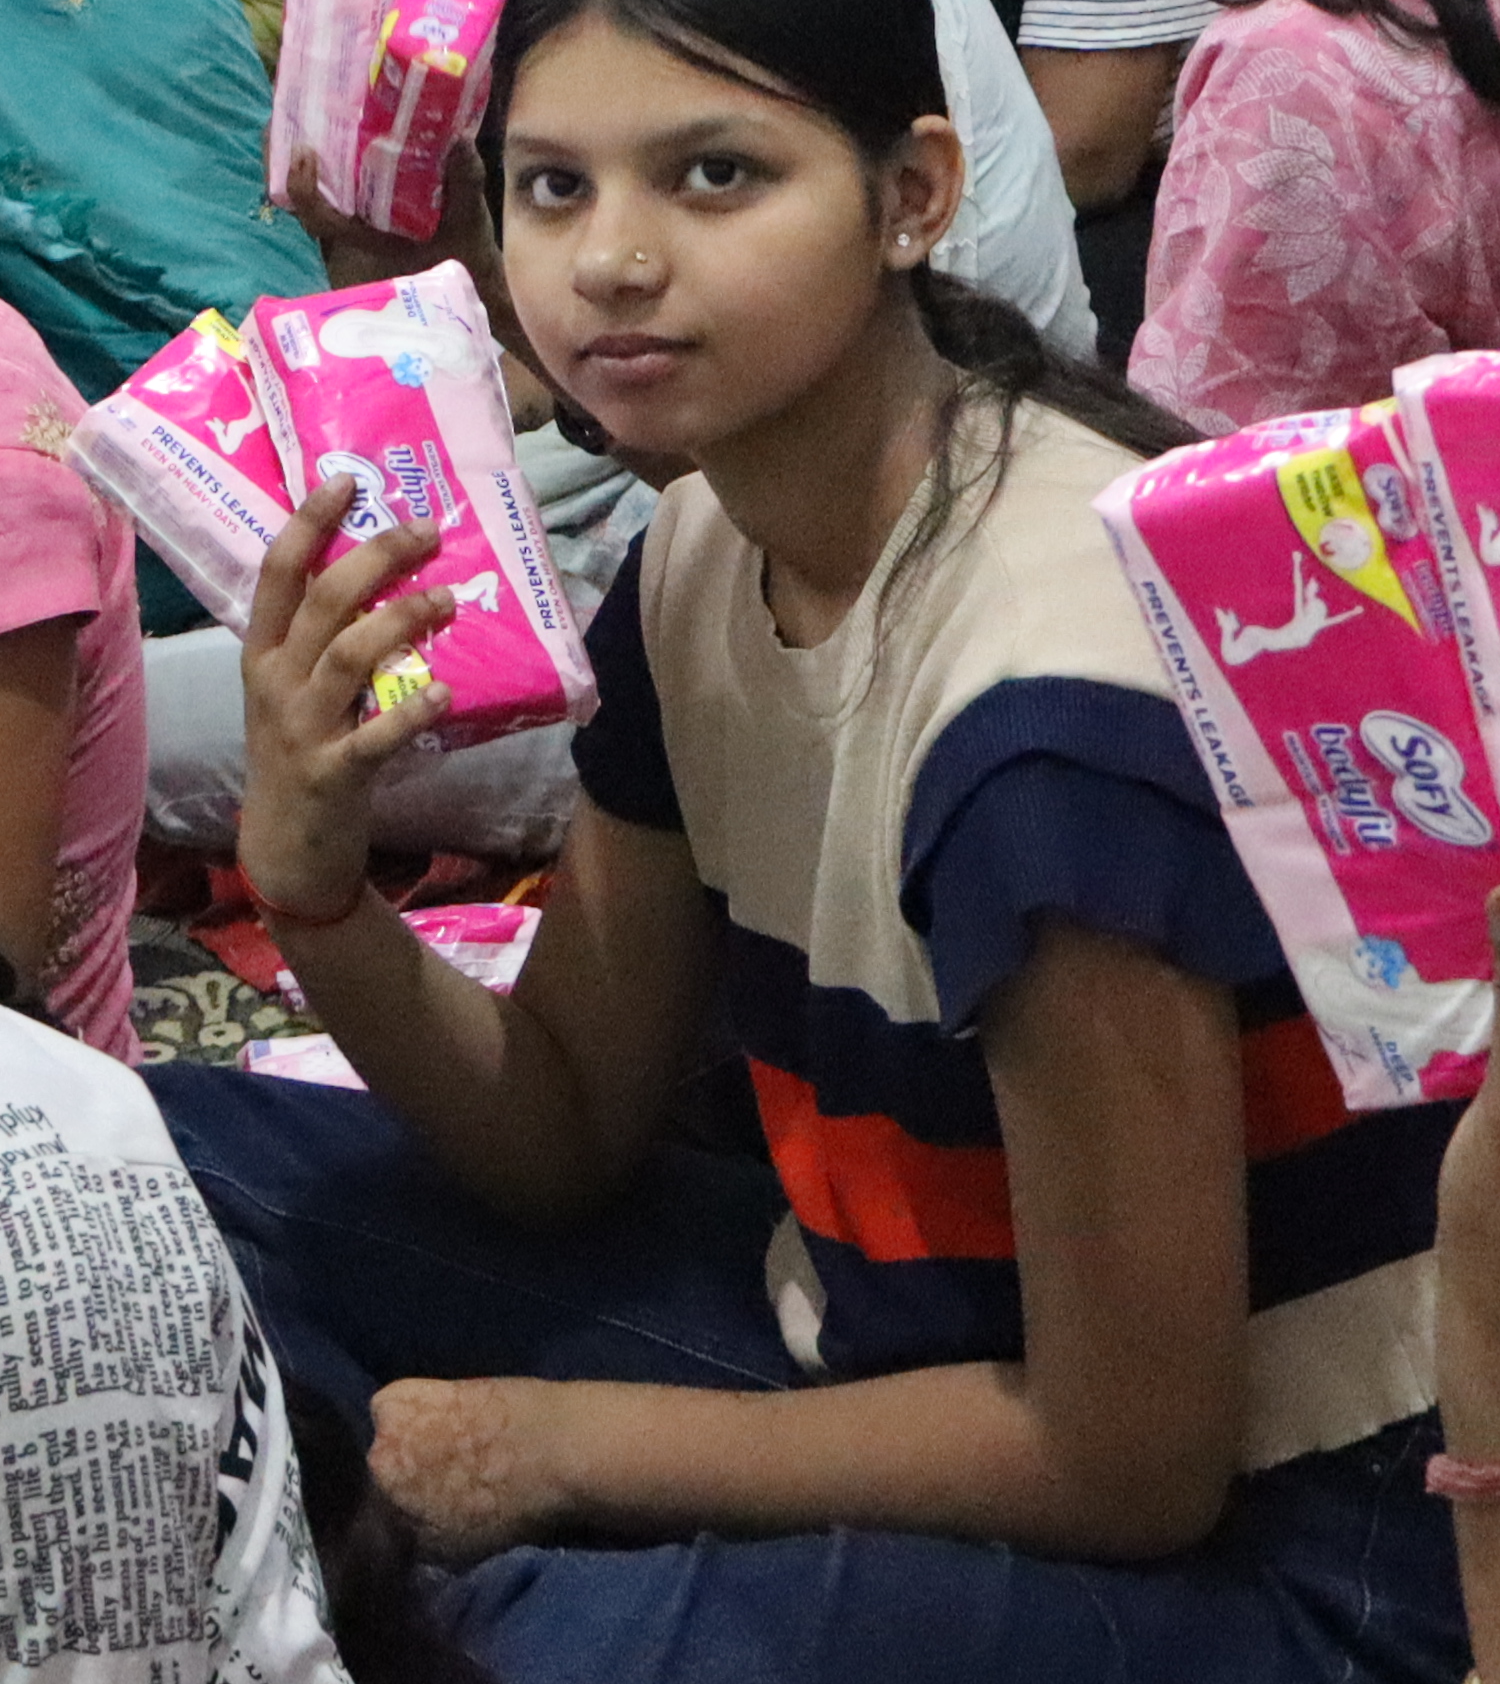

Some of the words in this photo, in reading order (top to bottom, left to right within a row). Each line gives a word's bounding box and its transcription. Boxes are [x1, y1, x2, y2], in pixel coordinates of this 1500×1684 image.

[401, 288, 417, 318] DEEP
[141, 438, 169, 465] EVEN
[167, 462, 184, 480] ON
[183, 477, 216, 508] HEAVY
[213, 506, 241, 535] DAYS
[152, 425, 223, 494] PREVENTS
[220, 491, 277, 547] LEAKAG
[387, 446, 433, 520] odyfit
[491, 469, 528, 542] LEAKAGE
[518, 546, 558, 631] PREVENTS
[553, 599, 569, 631] EVEN
[1421, 460, 1464, 592] PREVENTS
[1451, 601, 1497, 717] LEAKAGE
[1141, 579, 1204, 703] PREVENTS
[1194, 706, 1256, 810] LEAKAGE
[1311, 723, 1400, 850] bodyfit
[1390, 733, 1457, 820] SOFY
[1386, 1040, 1415, 1084] DEEP
[21, 1171, 36, 1189] to
[33, 1196, 59, 1251] seens
[15, 1278, 33, 1300] to
[34, 1283, 53, 1303] of
[50, 1259, 71, 1290] his
[0, 1315, 15, 1338] in
[61, 1300, 76, 1321] in
[22, 1310, 43, 1368] seens
[43, 1304, 70, 1406] beginning
[1, 1353, 28, 1412] guilty
[29, 1378, 50, 1411] his
[66, 1337, 92, 1397] guilty
[1, 1444, 16, 1465] as
[2, 1469, 31, 1543] passing
[12, 1548, 27, 1568] to
[15, 1576, 37, 1625] seens
[22, 1638, 40, 1667] his
